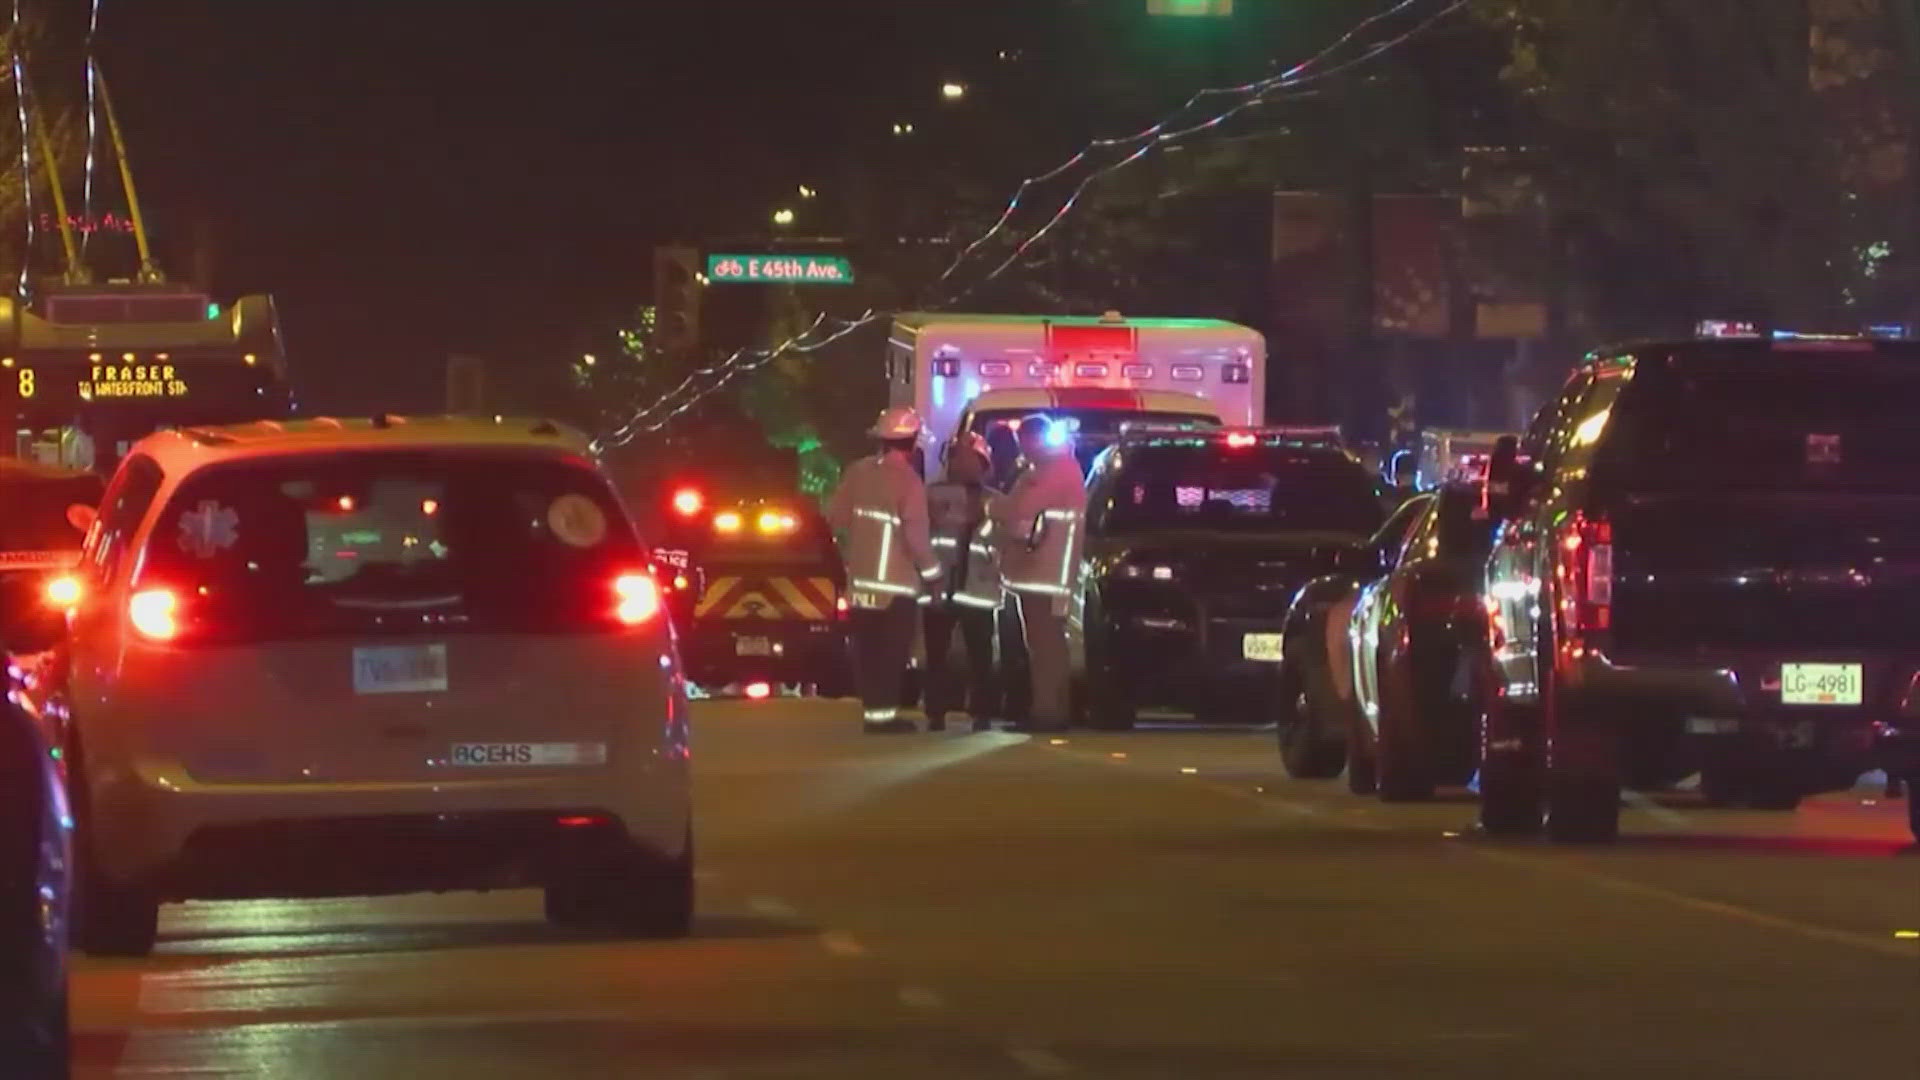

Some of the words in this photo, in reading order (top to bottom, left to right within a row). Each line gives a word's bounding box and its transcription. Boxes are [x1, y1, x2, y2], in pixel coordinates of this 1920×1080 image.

[748, 260, 759, 277] E
[763, 260, 803, 278] 45th
[806, 260, 843, 279] Ave.
[18, 368, 35, 397] 8
[92, 366, 175, 381] FRASER
[95, 380, 163, 396] WATERFRONT
[1784, 673, 1807, 693] LG
[1816, 673, 1856, 694] 4981
